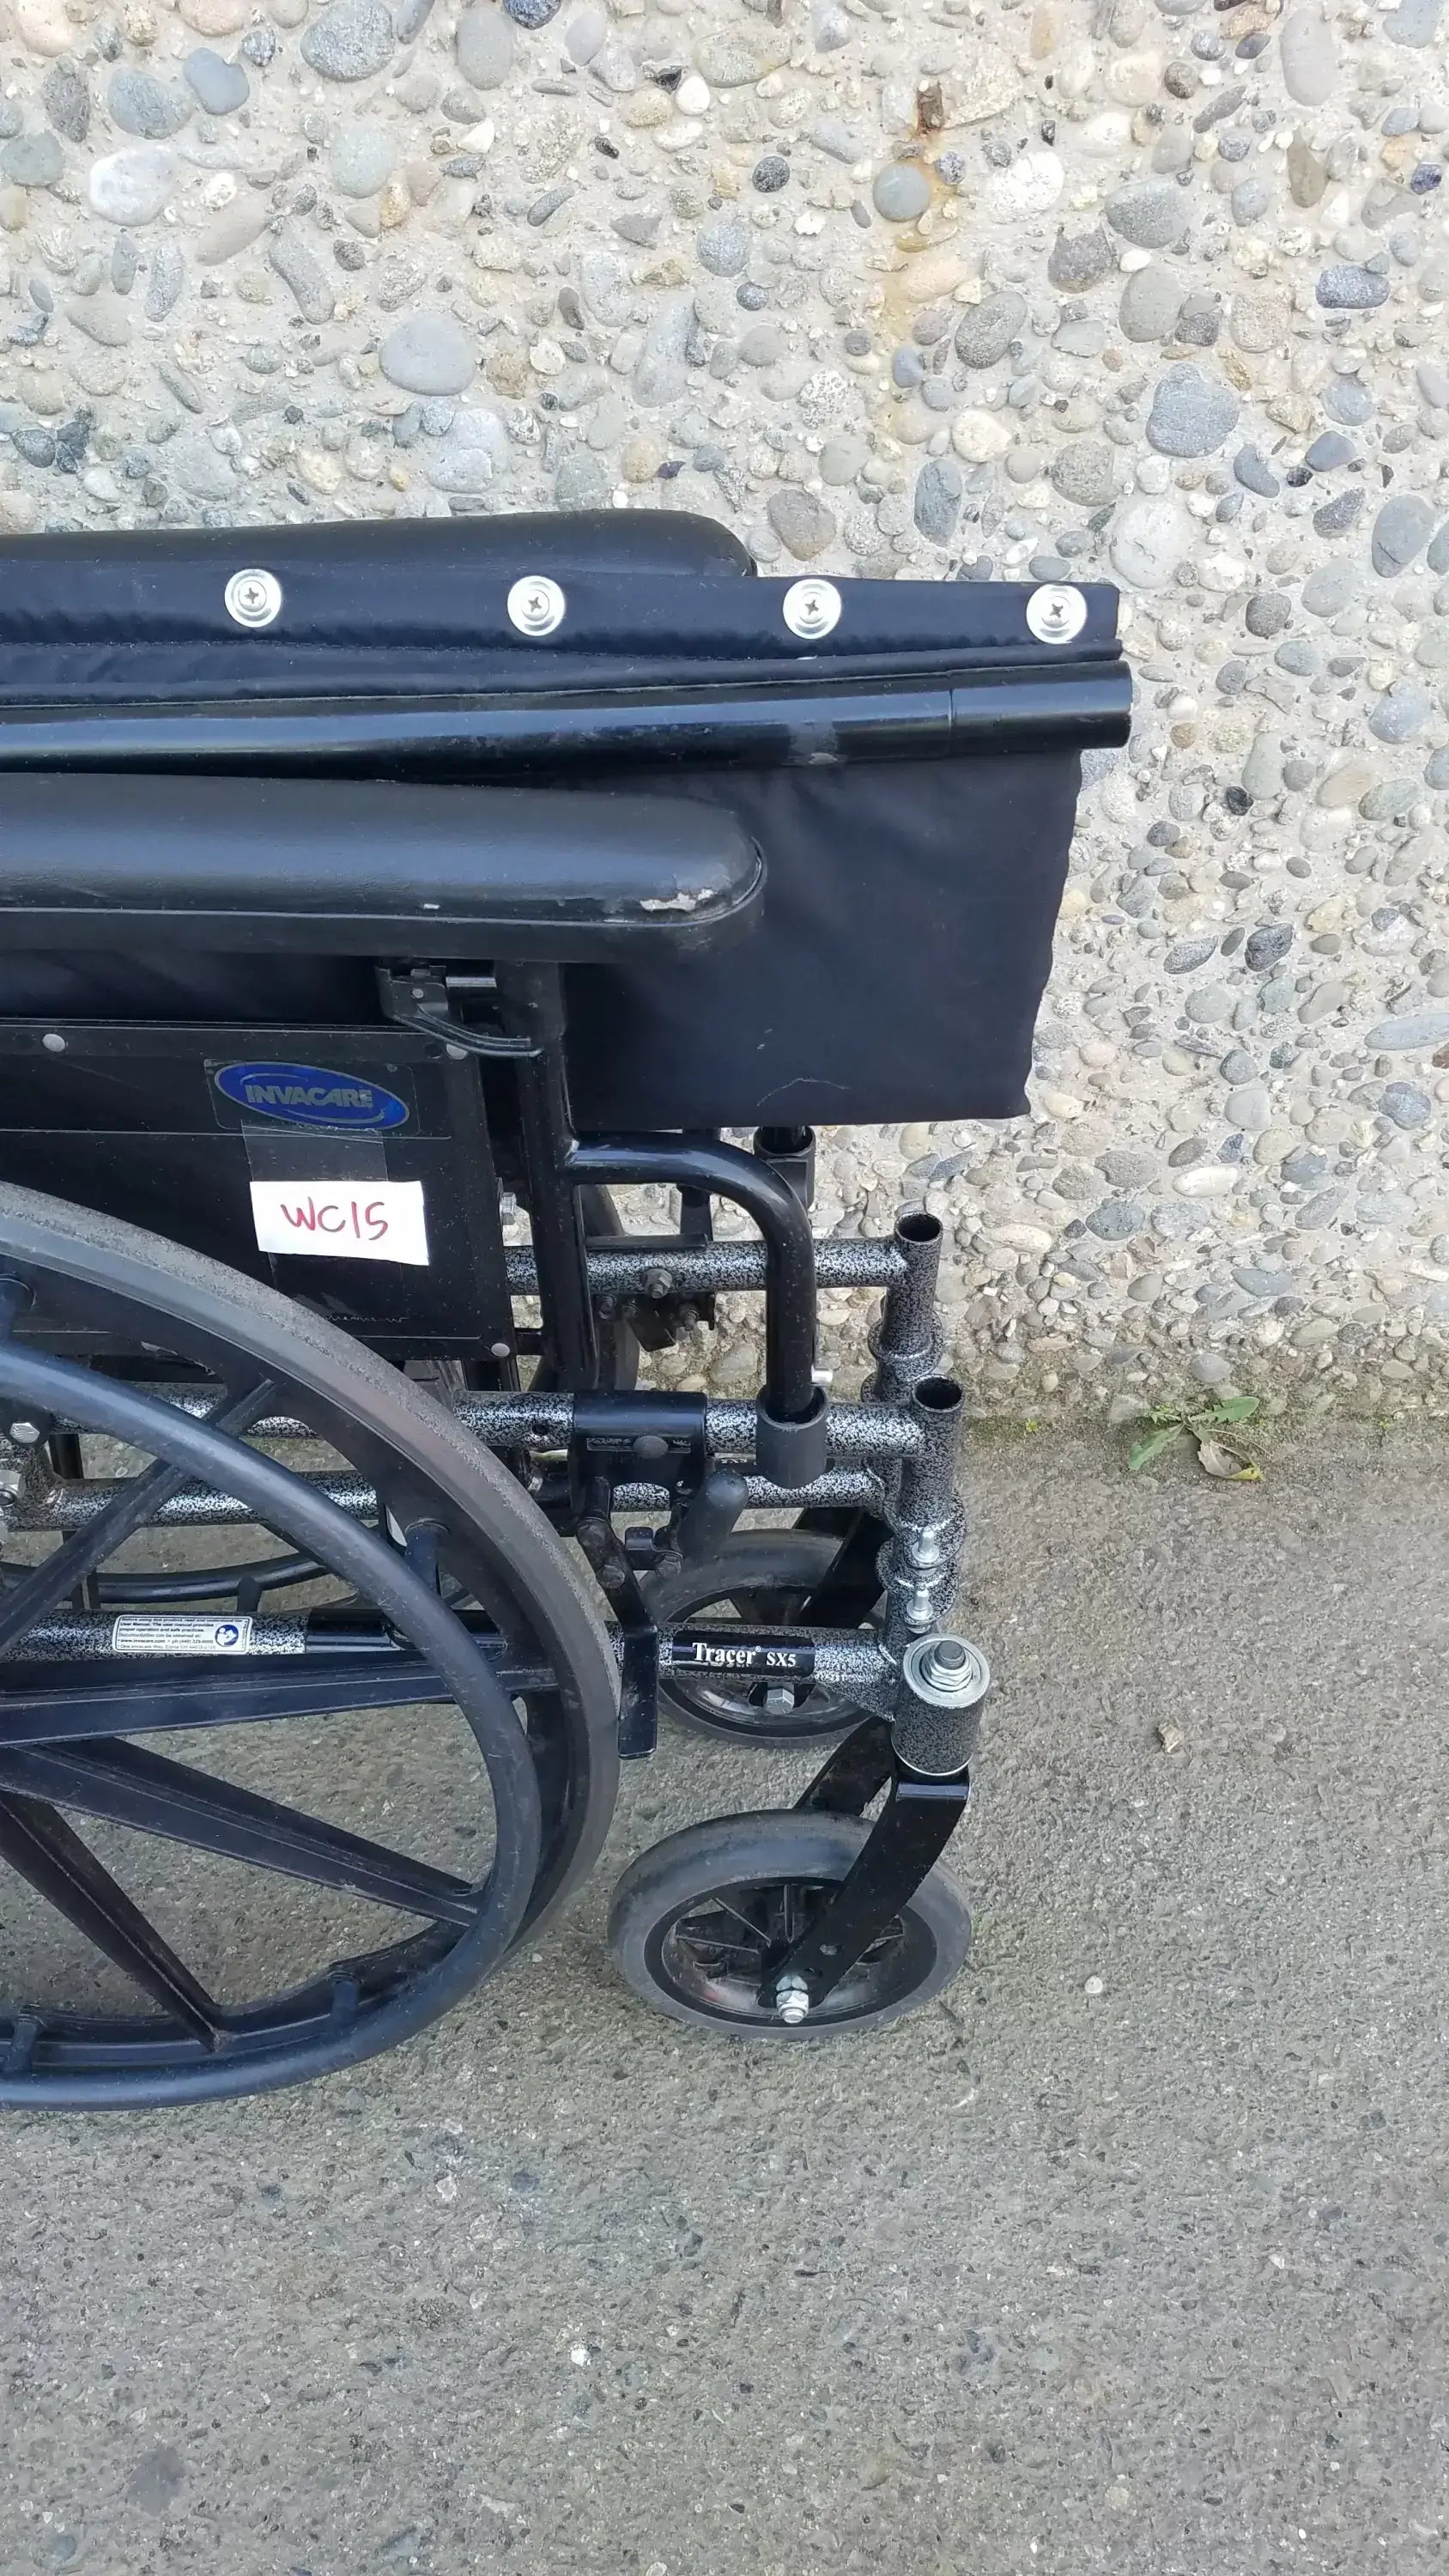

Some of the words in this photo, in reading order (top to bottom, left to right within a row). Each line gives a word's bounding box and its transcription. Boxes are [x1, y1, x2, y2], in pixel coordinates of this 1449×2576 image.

[245, 1084, 373, 1108] INVACARE
[280, 1196, 389, 1241] WC15
[767, 1651, 796, 1667] SX5
